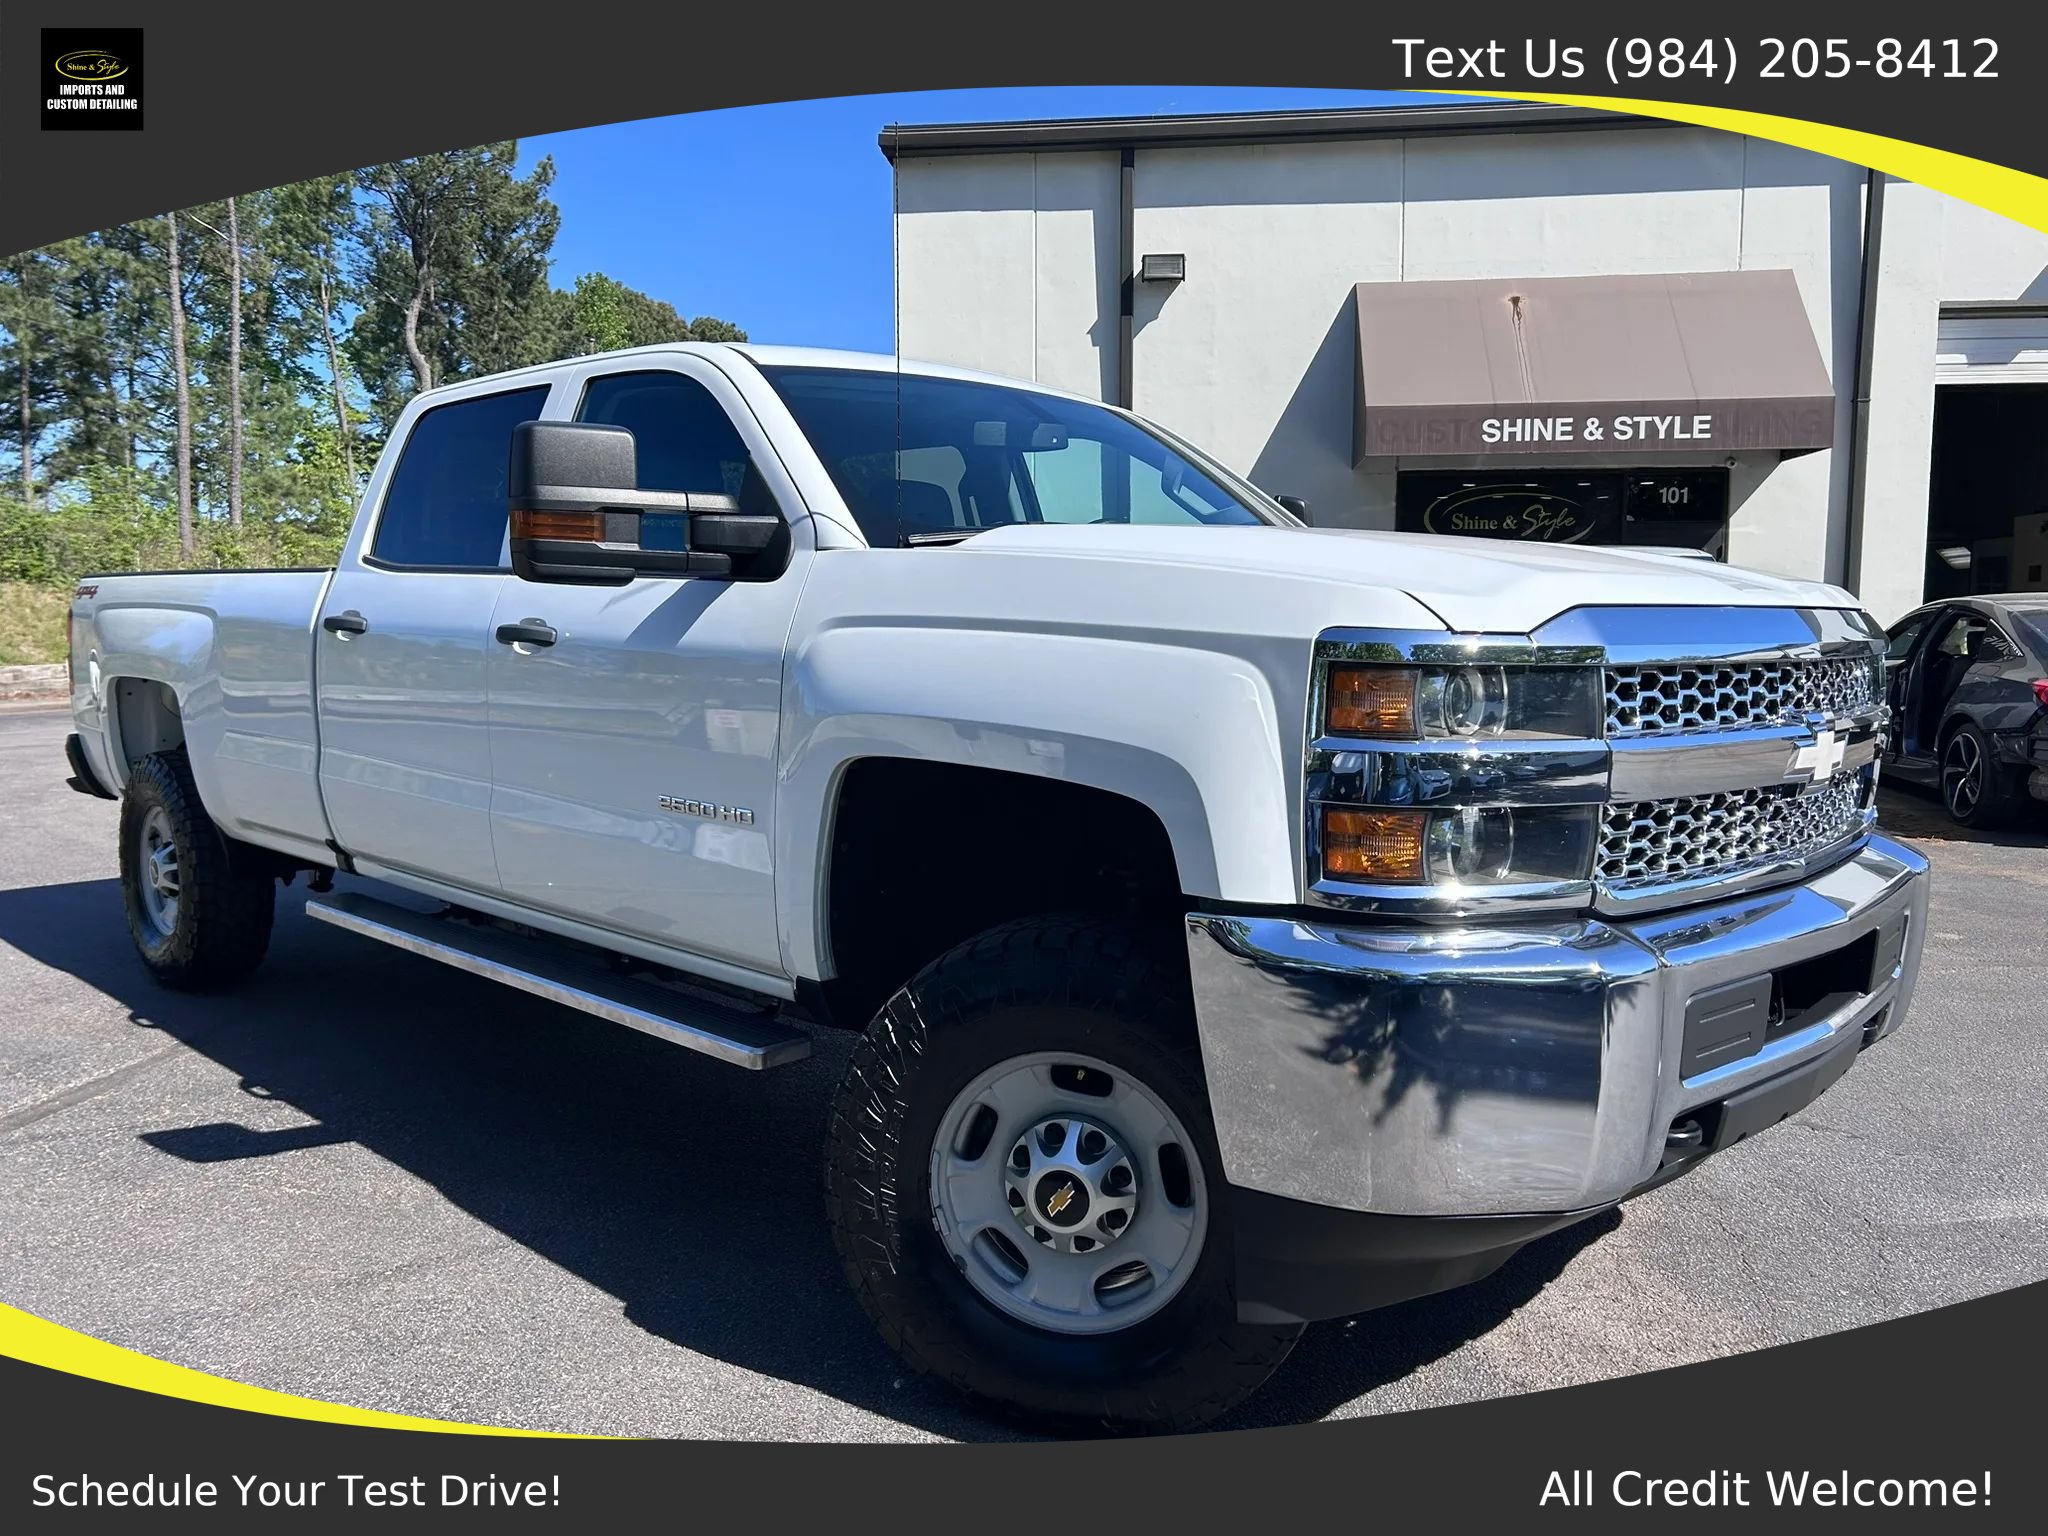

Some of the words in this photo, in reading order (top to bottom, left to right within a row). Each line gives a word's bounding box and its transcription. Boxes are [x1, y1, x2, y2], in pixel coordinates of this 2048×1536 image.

[1481, 417, 1574, 443] SHINE
[1583, 417, 1604, 441] &
[1613, 415, 1712, 441] STYLE
[1659, 486, 1689, 504] 101
[1451, 513, 1498, 530] Shine
[1503, 515, 1518, 529] &
[1521, 503, 1576, 539] Style
[658, 795, 716, 818] 2500
[720, 805, 754, 824] HD
